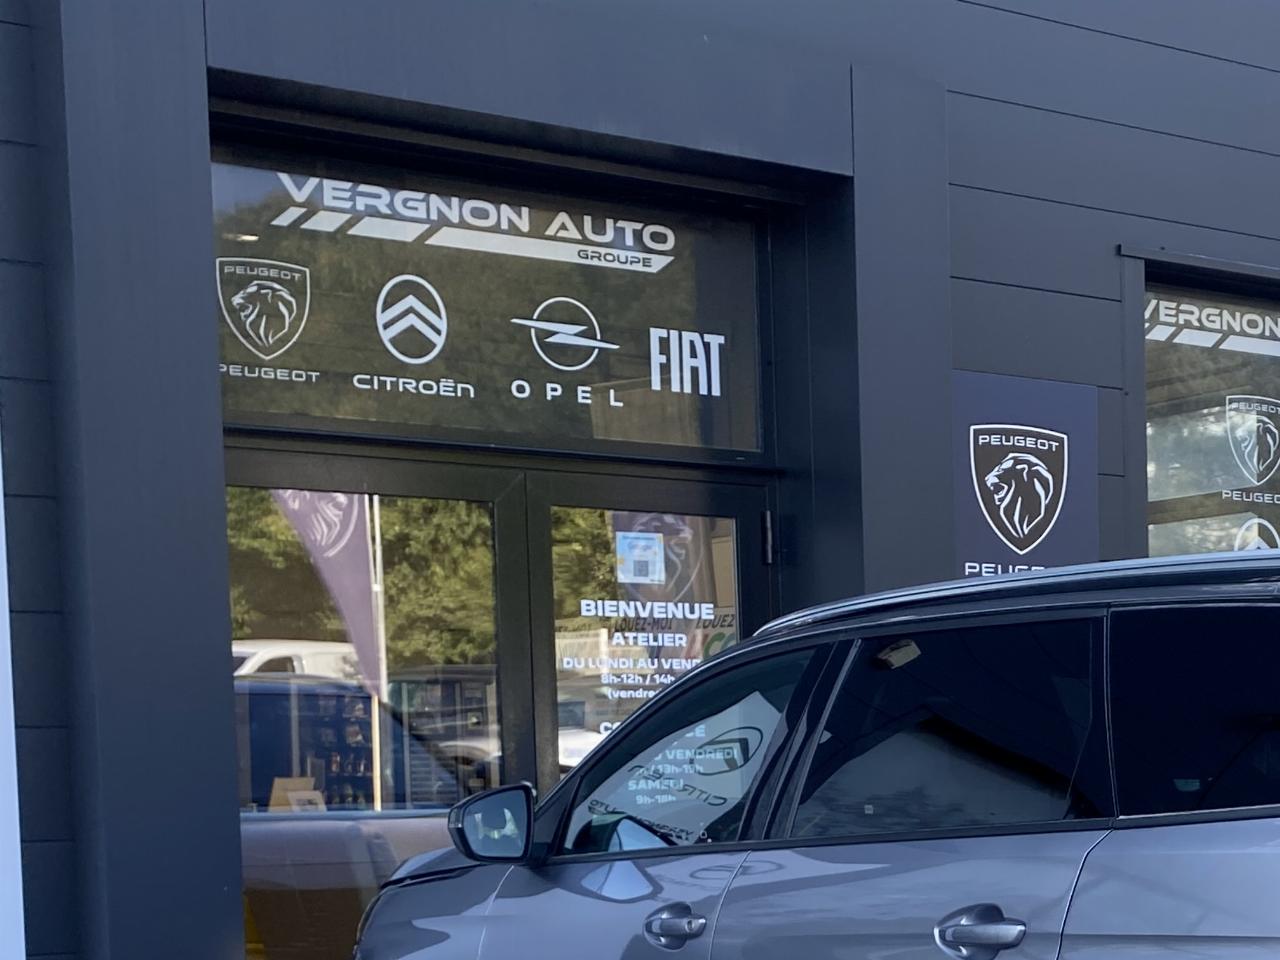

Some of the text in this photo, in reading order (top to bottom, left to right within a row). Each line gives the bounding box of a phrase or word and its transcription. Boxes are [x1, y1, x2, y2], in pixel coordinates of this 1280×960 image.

[276, 172, 677, 252] VERGNON AUTO
[577, 248, 653, 269] GROUPE
[224, 265, 303, 281] PEUGEOT
[649, 327, 725, 396] FIAT
[511, 379, 625, 407] OPEL
[978, 435, 1060, 452] PEUGEOT
[580, 600, 715, 620] BIENVENUE
[612, 632, 688, 648] ATELIER
[563, 658, 585, 669] DU
[589, 658, 634, 670] LUNDI
[638, 658, 658, 670] AU
